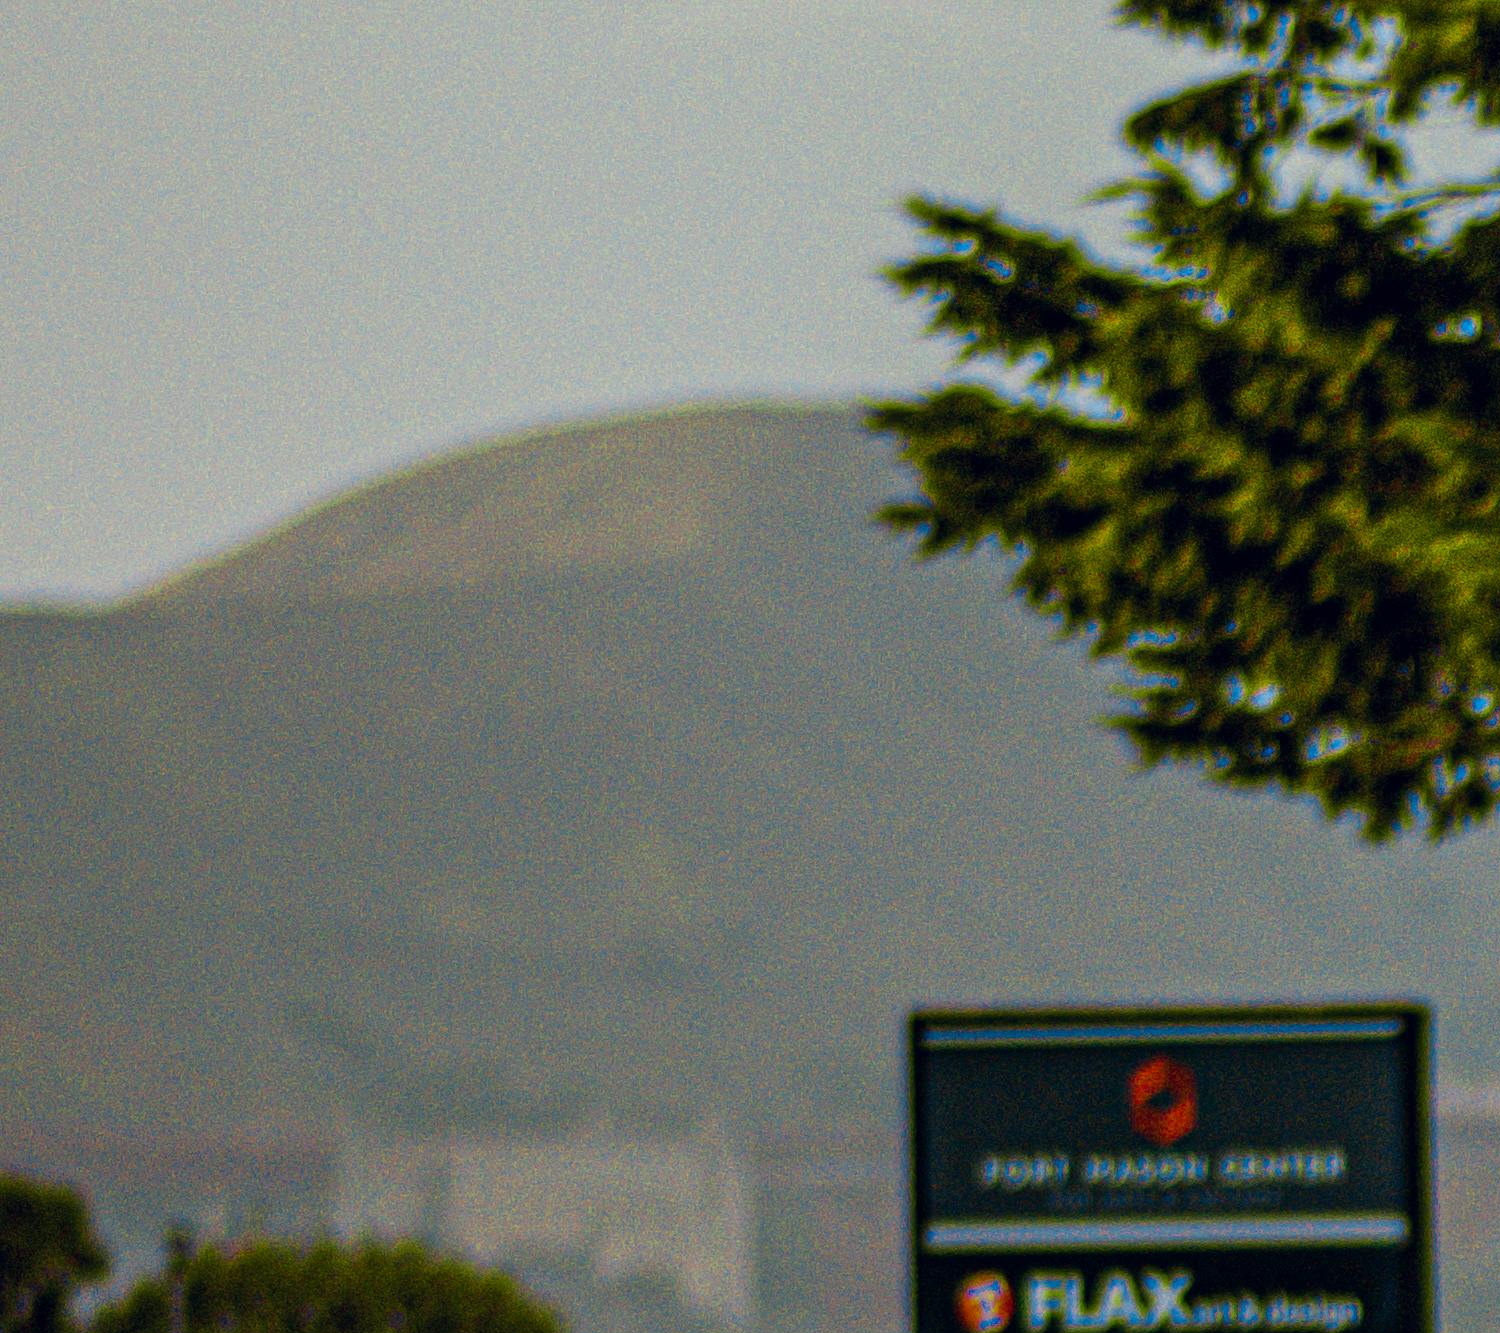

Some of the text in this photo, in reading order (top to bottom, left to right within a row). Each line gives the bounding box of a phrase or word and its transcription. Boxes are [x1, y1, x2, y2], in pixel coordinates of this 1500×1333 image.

[982, 1152, 1344, 1186] FORT MASON CENTER
[1027, 1275, 1190, 1328] FLAX
[1265, 1295, 1360, 1332] design
